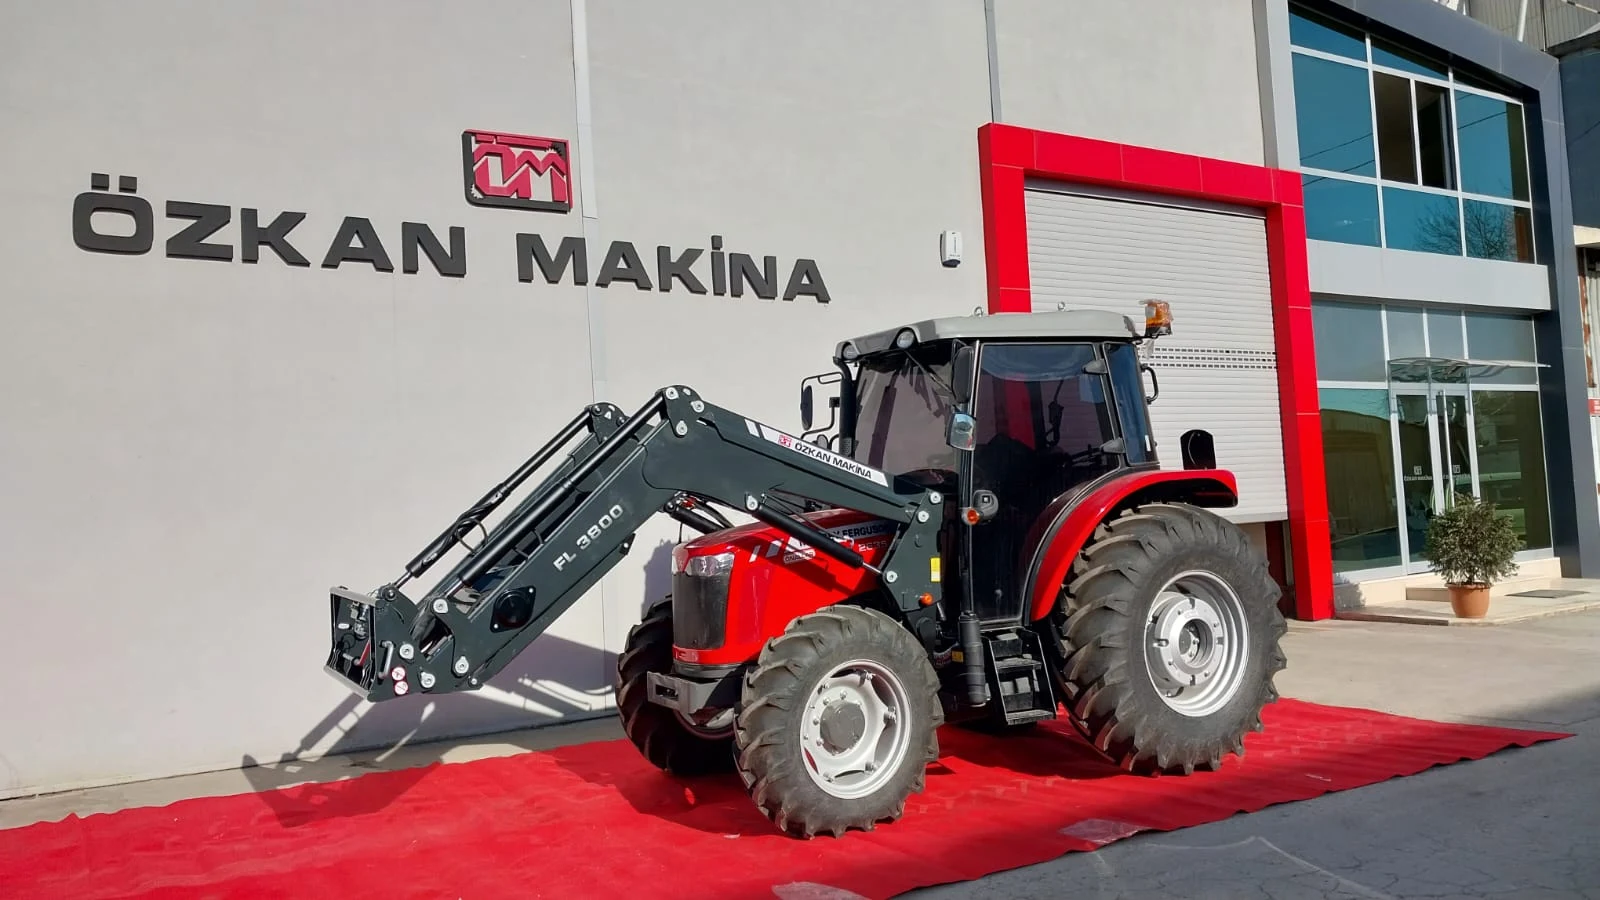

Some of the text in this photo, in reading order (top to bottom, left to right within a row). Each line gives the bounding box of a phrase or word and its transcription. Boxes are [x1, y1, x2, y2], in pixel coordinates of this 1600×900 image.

[72, 172, 831, 304] ÖZKAN MAKİNA
[832, 457, 872, 479] MAKİNA
[553, 504, 623, 571] FL 3800
